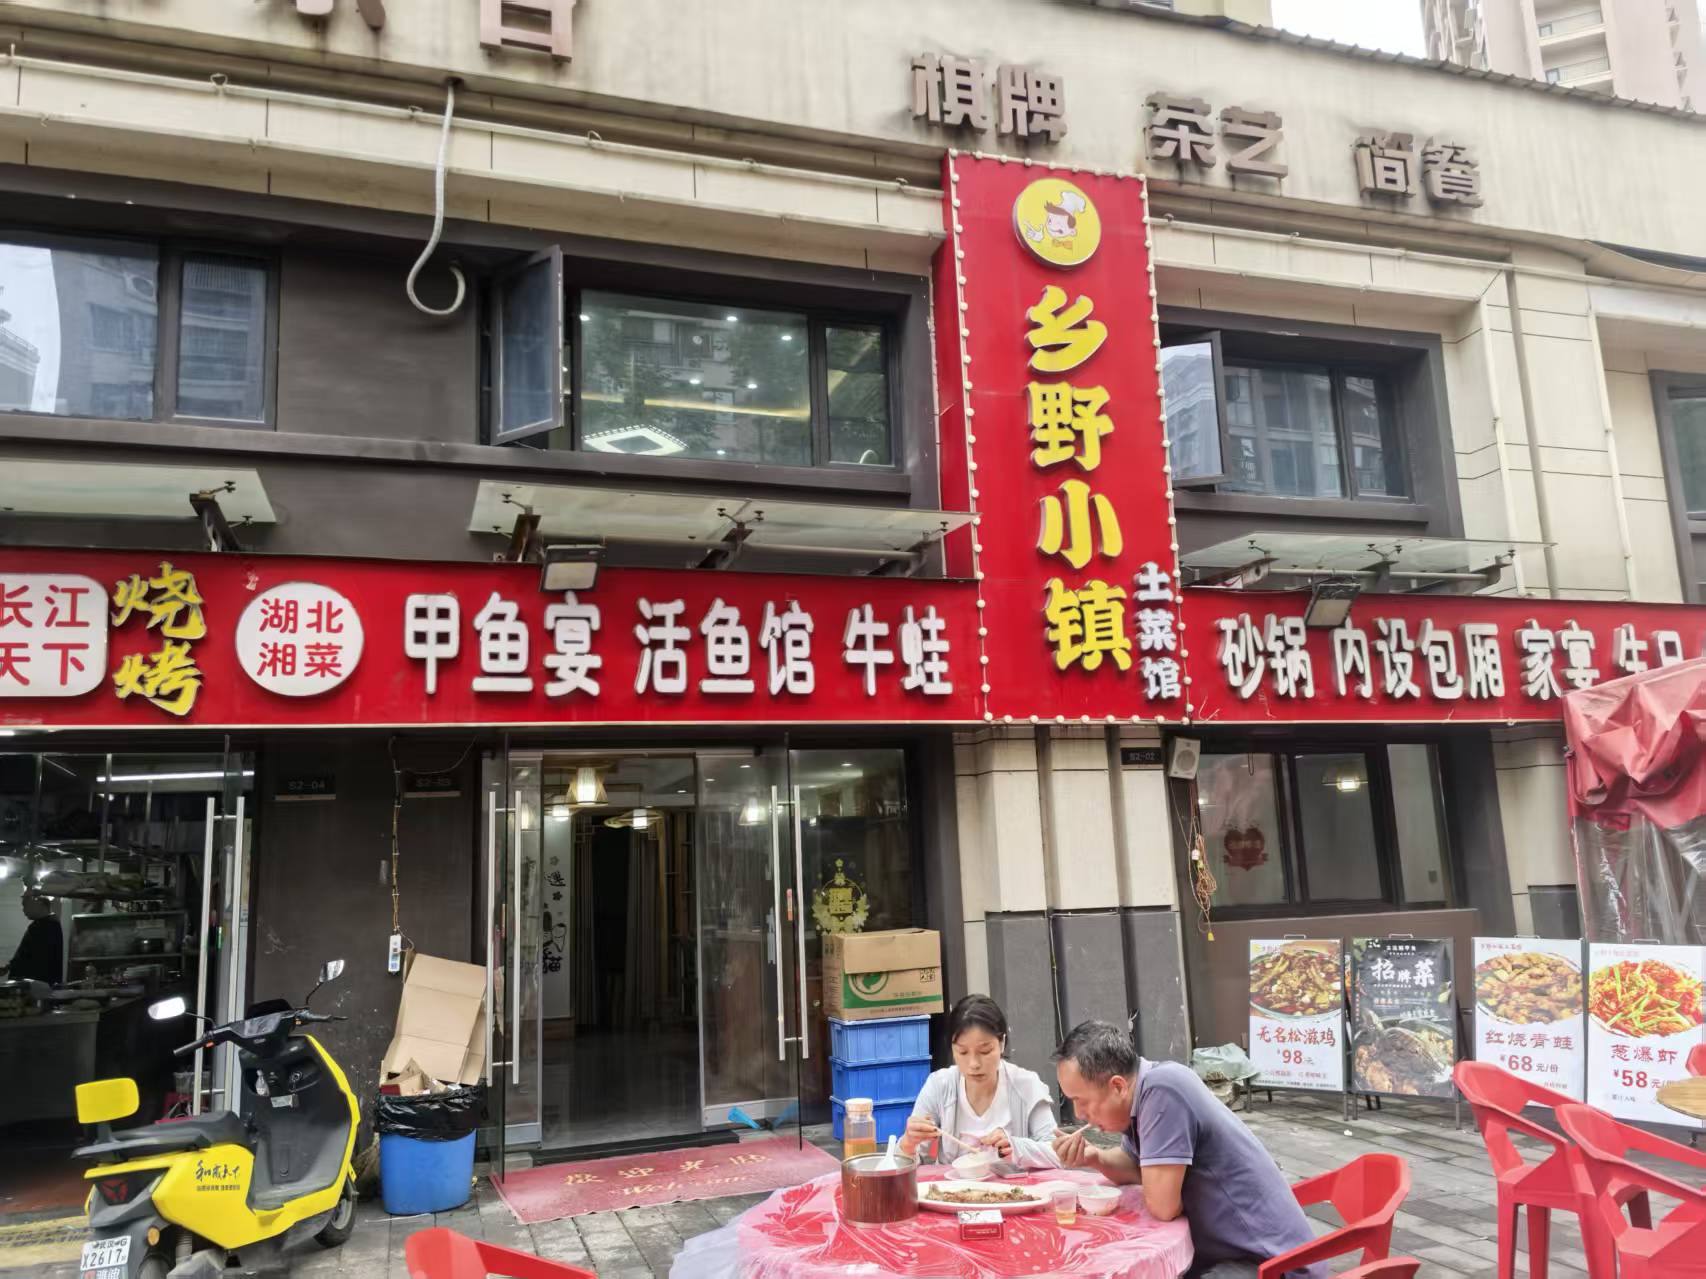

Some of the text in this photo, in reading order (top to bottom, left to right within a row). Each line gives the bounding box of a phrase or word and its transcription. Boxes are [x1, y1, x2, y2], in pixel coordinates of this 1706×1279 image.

[910, 52, 1067, 142] 棋牌
[1144, 91, 1289, 180] 茶艺
[1353, 130, 1484, 208] 简餐
[1025, 285, 1133, 672] 乡野小镇
[111, 561, 207, 716] 烧烤
[256, 642, 344, 679] 湘菜
[259, 598, 345, 635] 湖北
[404, 591, 953, 697] 甲鱼宴 活鱼馆 牛蛙
[1133, 561, 1182, 701] 土菜馆
[1216, 613, 1315, 700] 砂锅
[1328, 614, 1506, 701] 内设包厢
[1514, 619, 1601, 700] 家宴
[1370, 957, 1436, 988] 招牌菜
[1485, 1030, 1574, 1051] 红烧青蛙
[1611, 1044, 1678, 1065] 葱爆虾
